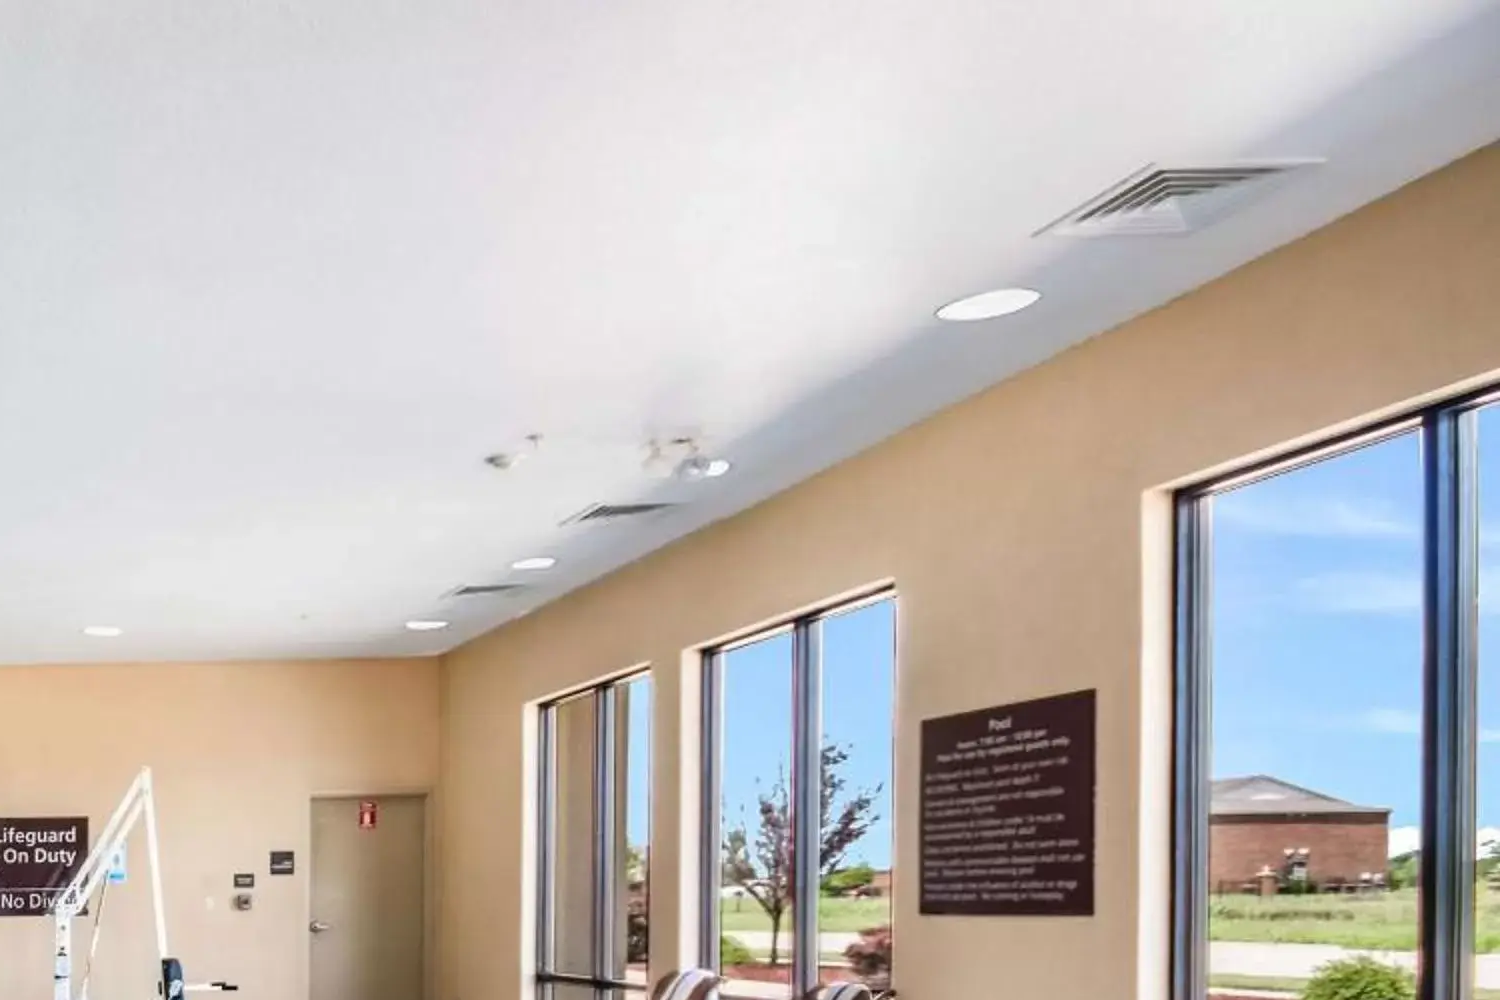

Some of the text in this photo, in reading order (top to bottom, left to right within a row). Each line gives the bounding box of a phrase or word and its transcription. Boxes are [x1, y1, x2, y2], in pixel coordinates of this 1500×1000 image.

[989, 716, 1012, 731] Pool
[3, 847, 77, 867] On Duty
[1, 893, 25, 909] No
